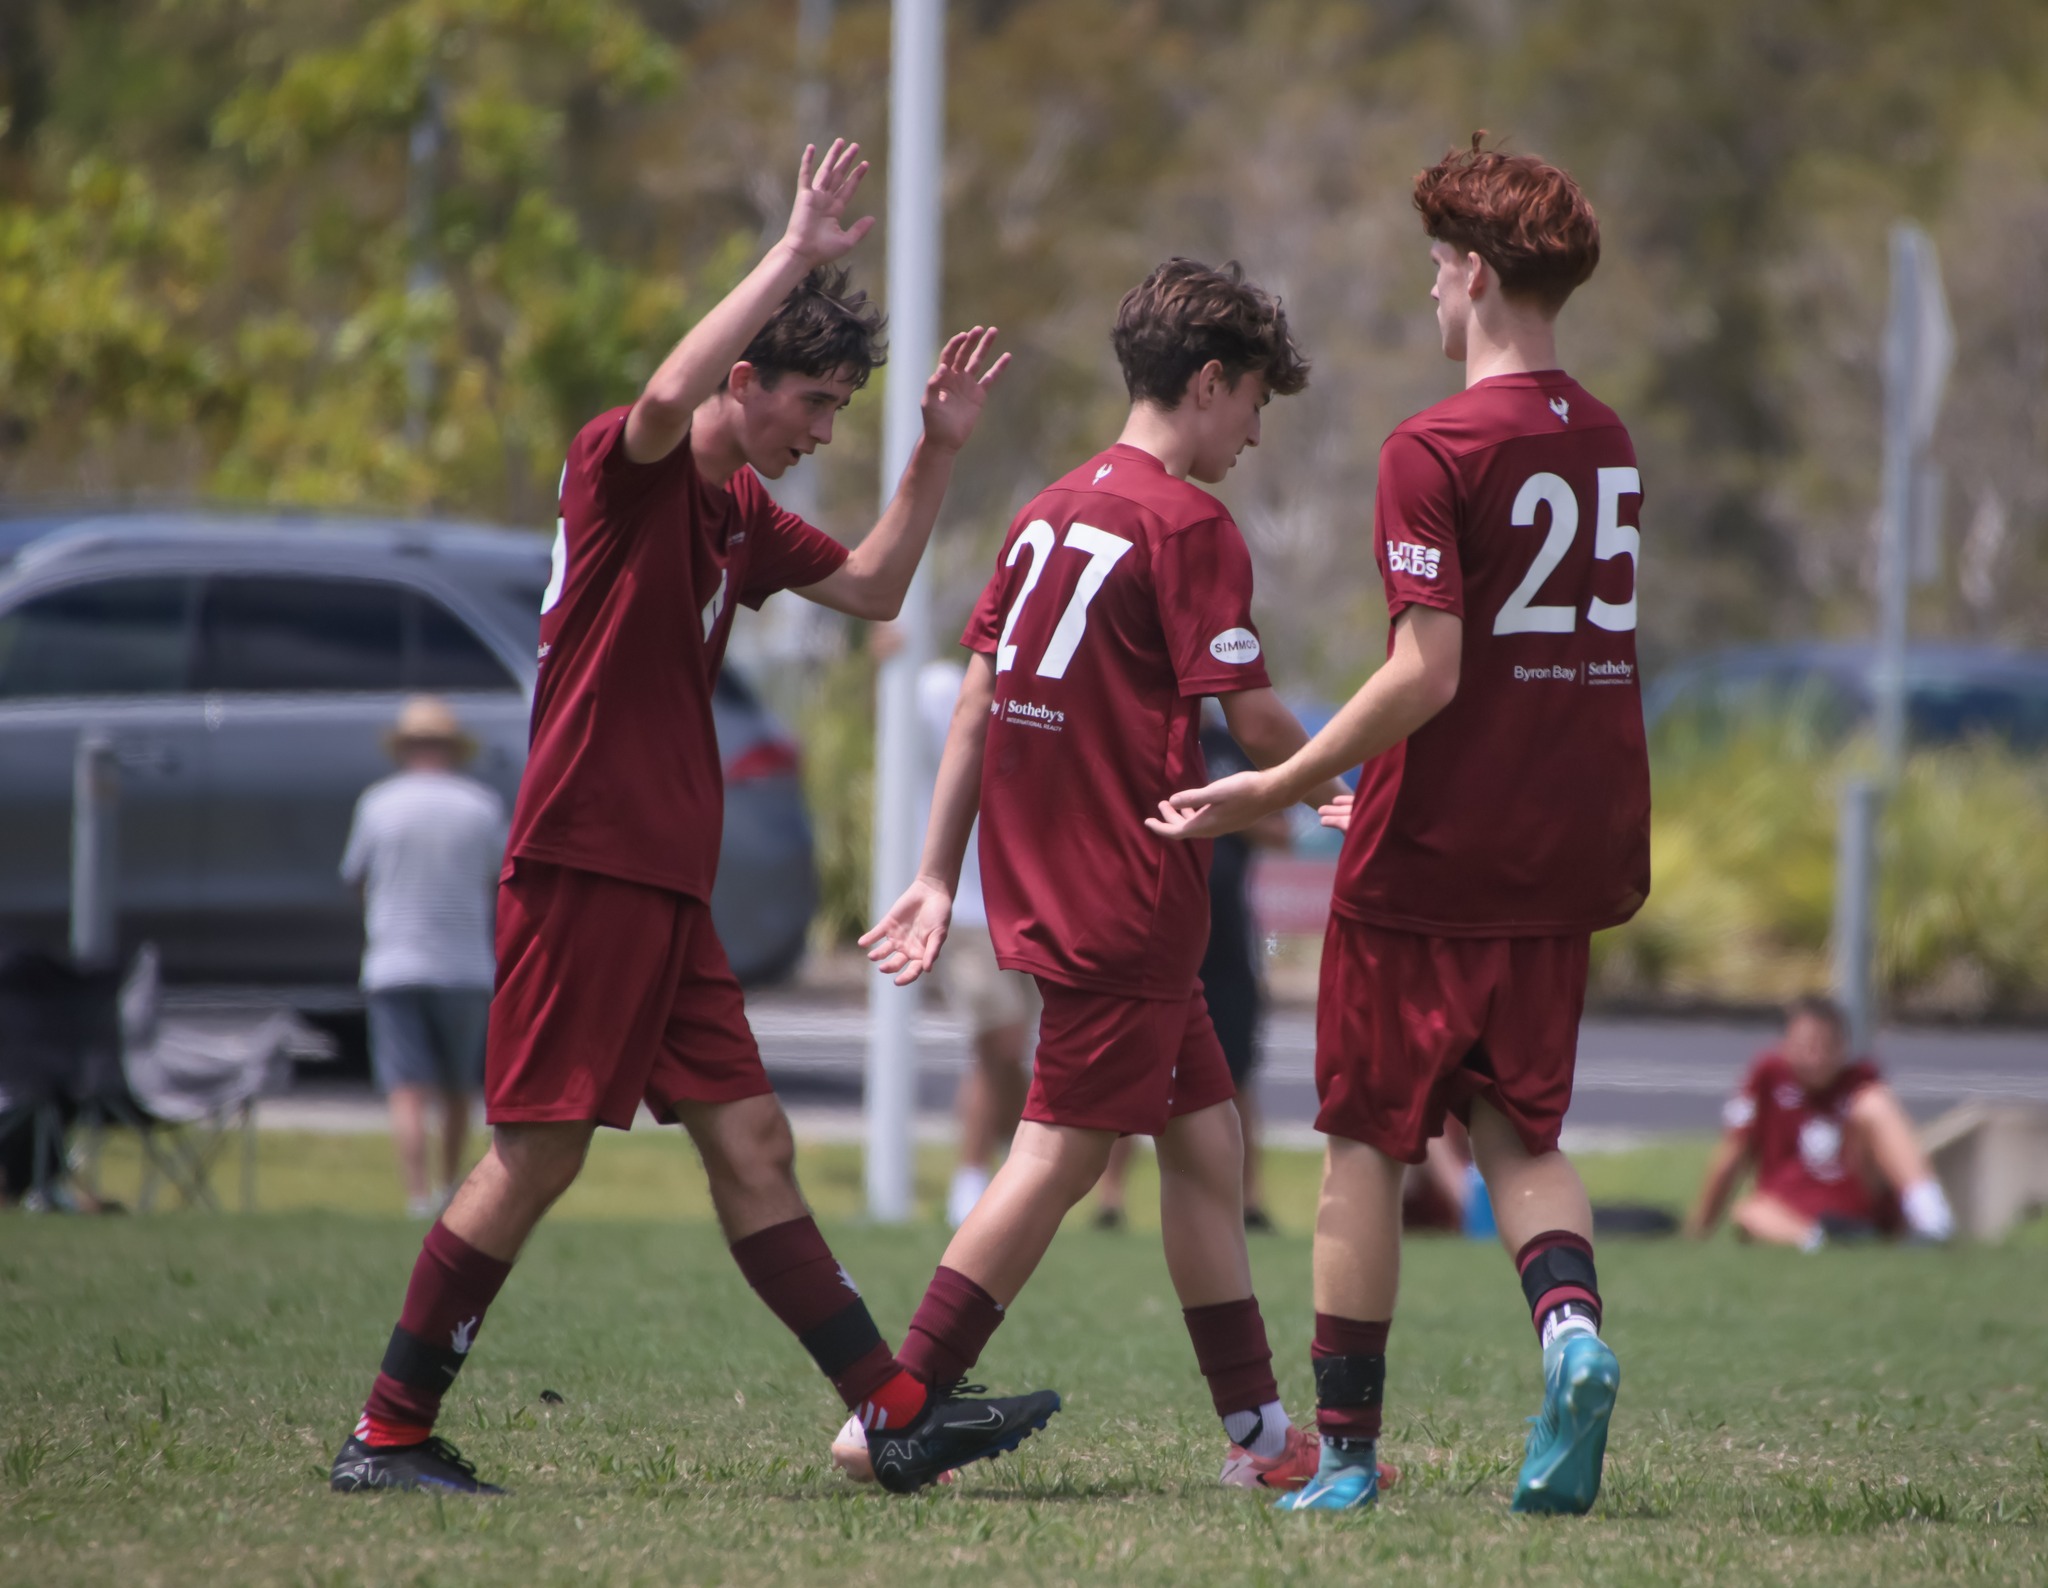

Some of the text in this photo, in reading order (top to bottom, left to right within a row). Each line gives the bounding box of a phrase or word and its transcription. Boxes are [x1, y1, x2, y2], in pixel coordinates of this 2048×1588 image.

[1387, 540, 1426, 561] LITE
[1492, 467, 1641, 636] 25
[996, 519, 1134, 679] 27
[1214, 639, 1257, 653] SIMMOS
[1513, 664, 1551, 682] Byron
[1552, 664, 1577, 682] Bay
[1007, 699, 1065, 723] Sotheby's
